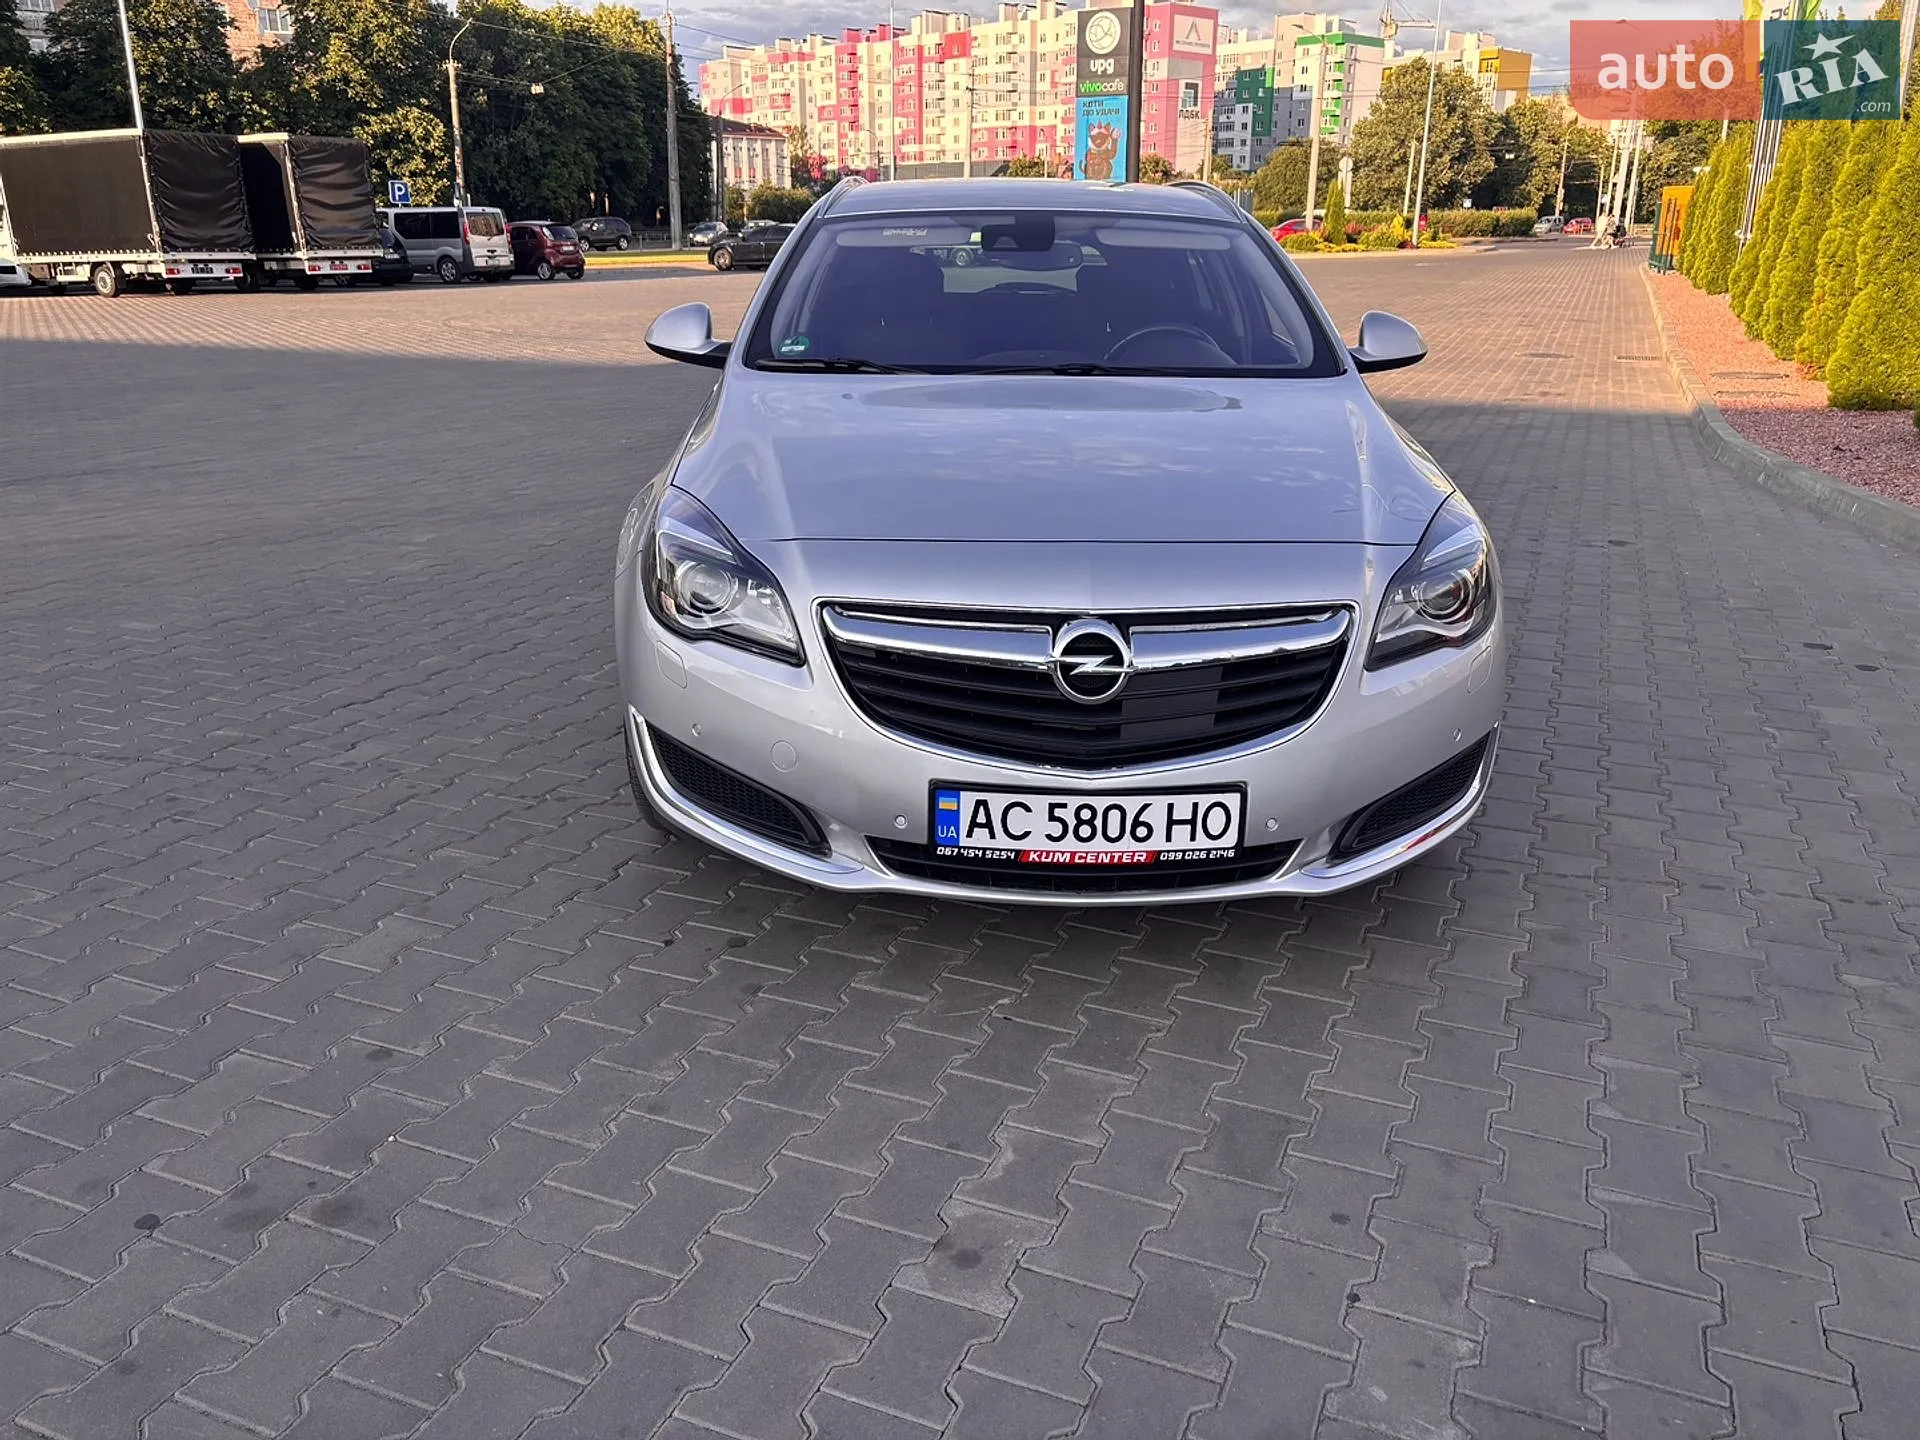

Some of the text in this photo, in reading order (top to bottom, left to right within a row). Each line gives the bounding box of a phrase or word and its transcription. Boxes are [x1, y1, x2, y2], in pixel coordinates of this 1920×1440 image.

[1090, 58, 1115, 75] upg
[394, 184, 405, 200] P
[965, 799, 1232, 843] AC 5806 HO
[938, 825, 957, 839] UA
[960, 848, 983, 858] 454
[1029, 851, 1147, 863] KUM CENTER
[1160, 849, 1236, 861] 099 026 2146
